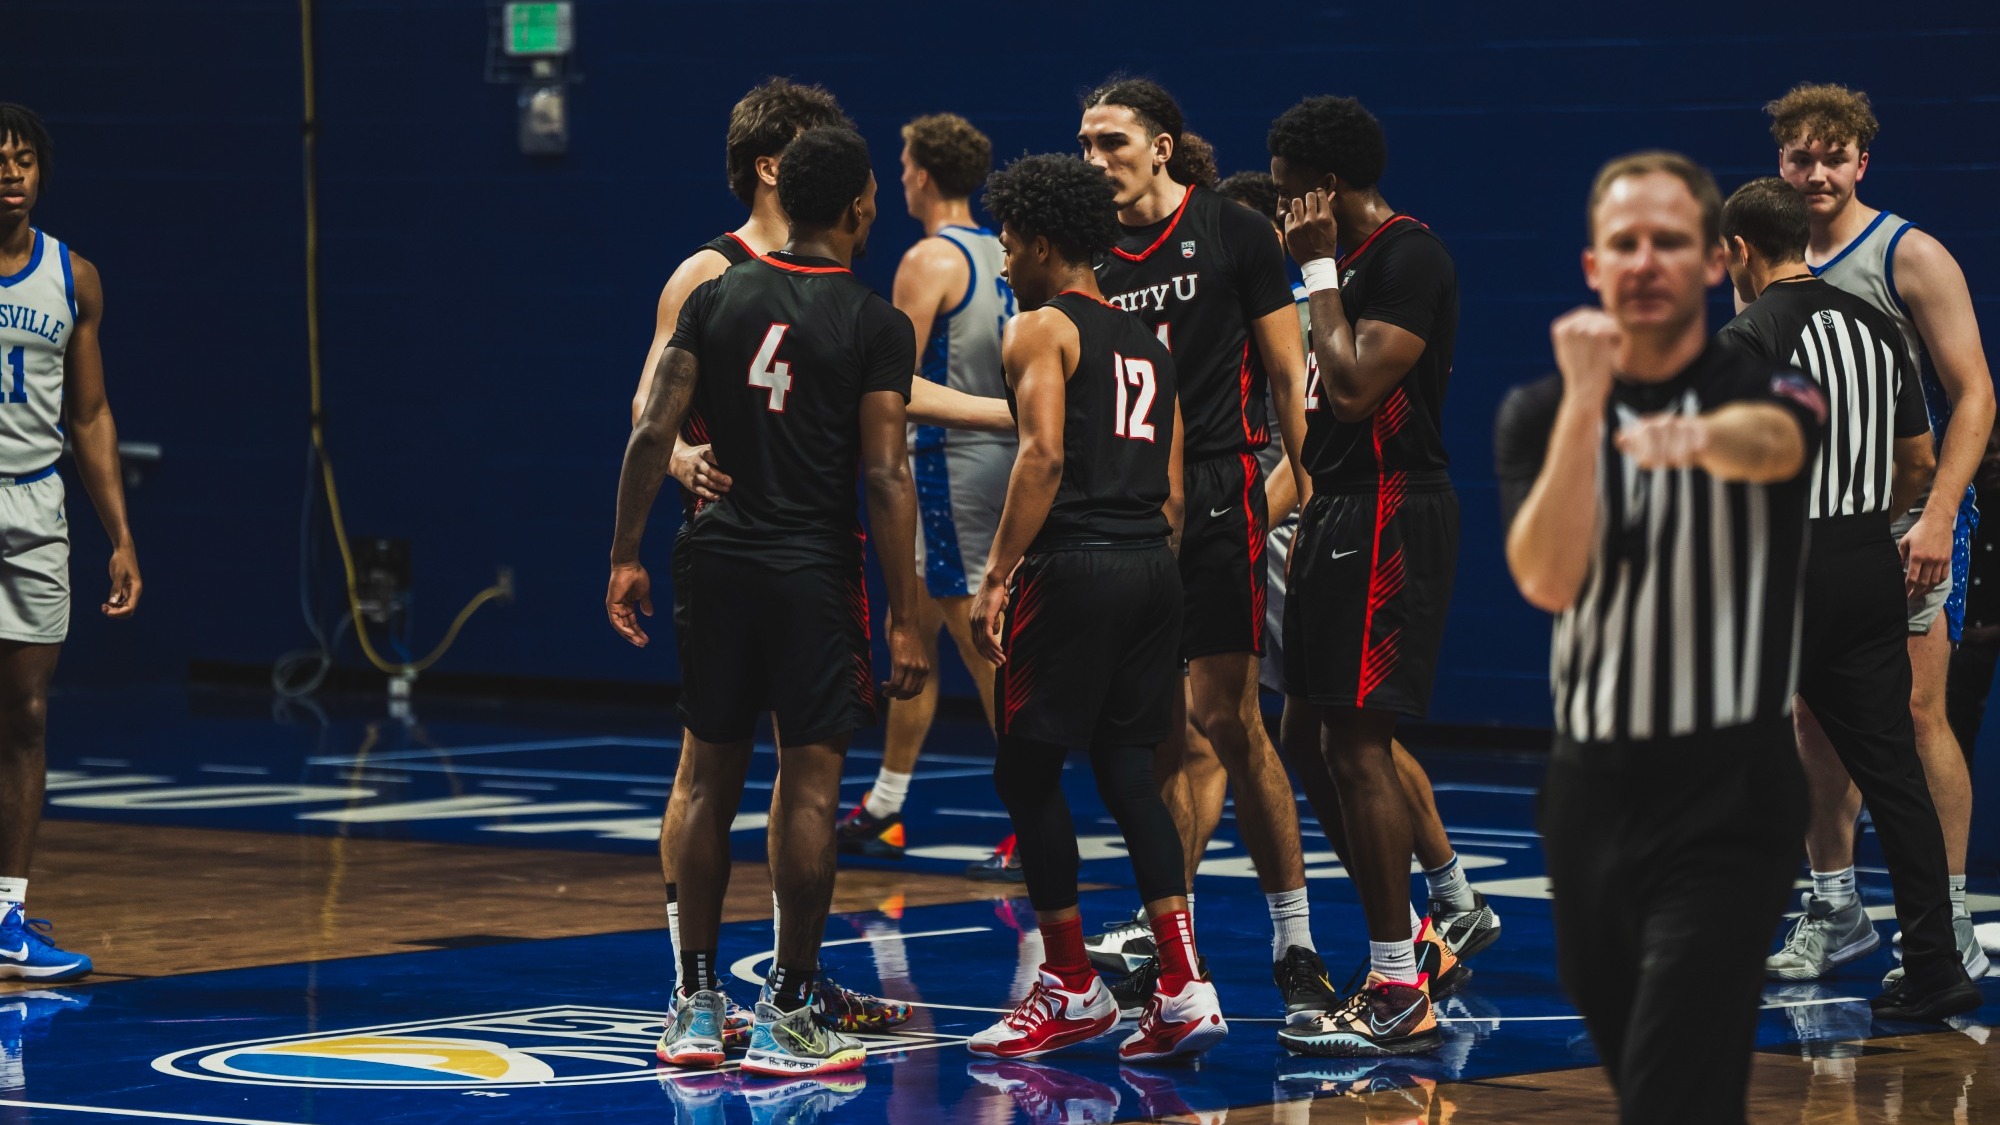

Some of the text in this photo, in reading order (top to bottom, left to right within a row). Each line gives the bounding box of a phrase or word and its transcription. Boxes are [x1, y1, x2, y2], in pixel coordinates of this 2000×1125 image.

[1103, 272, 1199, 312] arry U
[0, 304, 65, 344] SVILLE
[0, 345, 28, 404] 1
[747, 321, 794, 413] 4
[1113, 351, 1158, 444] 12
